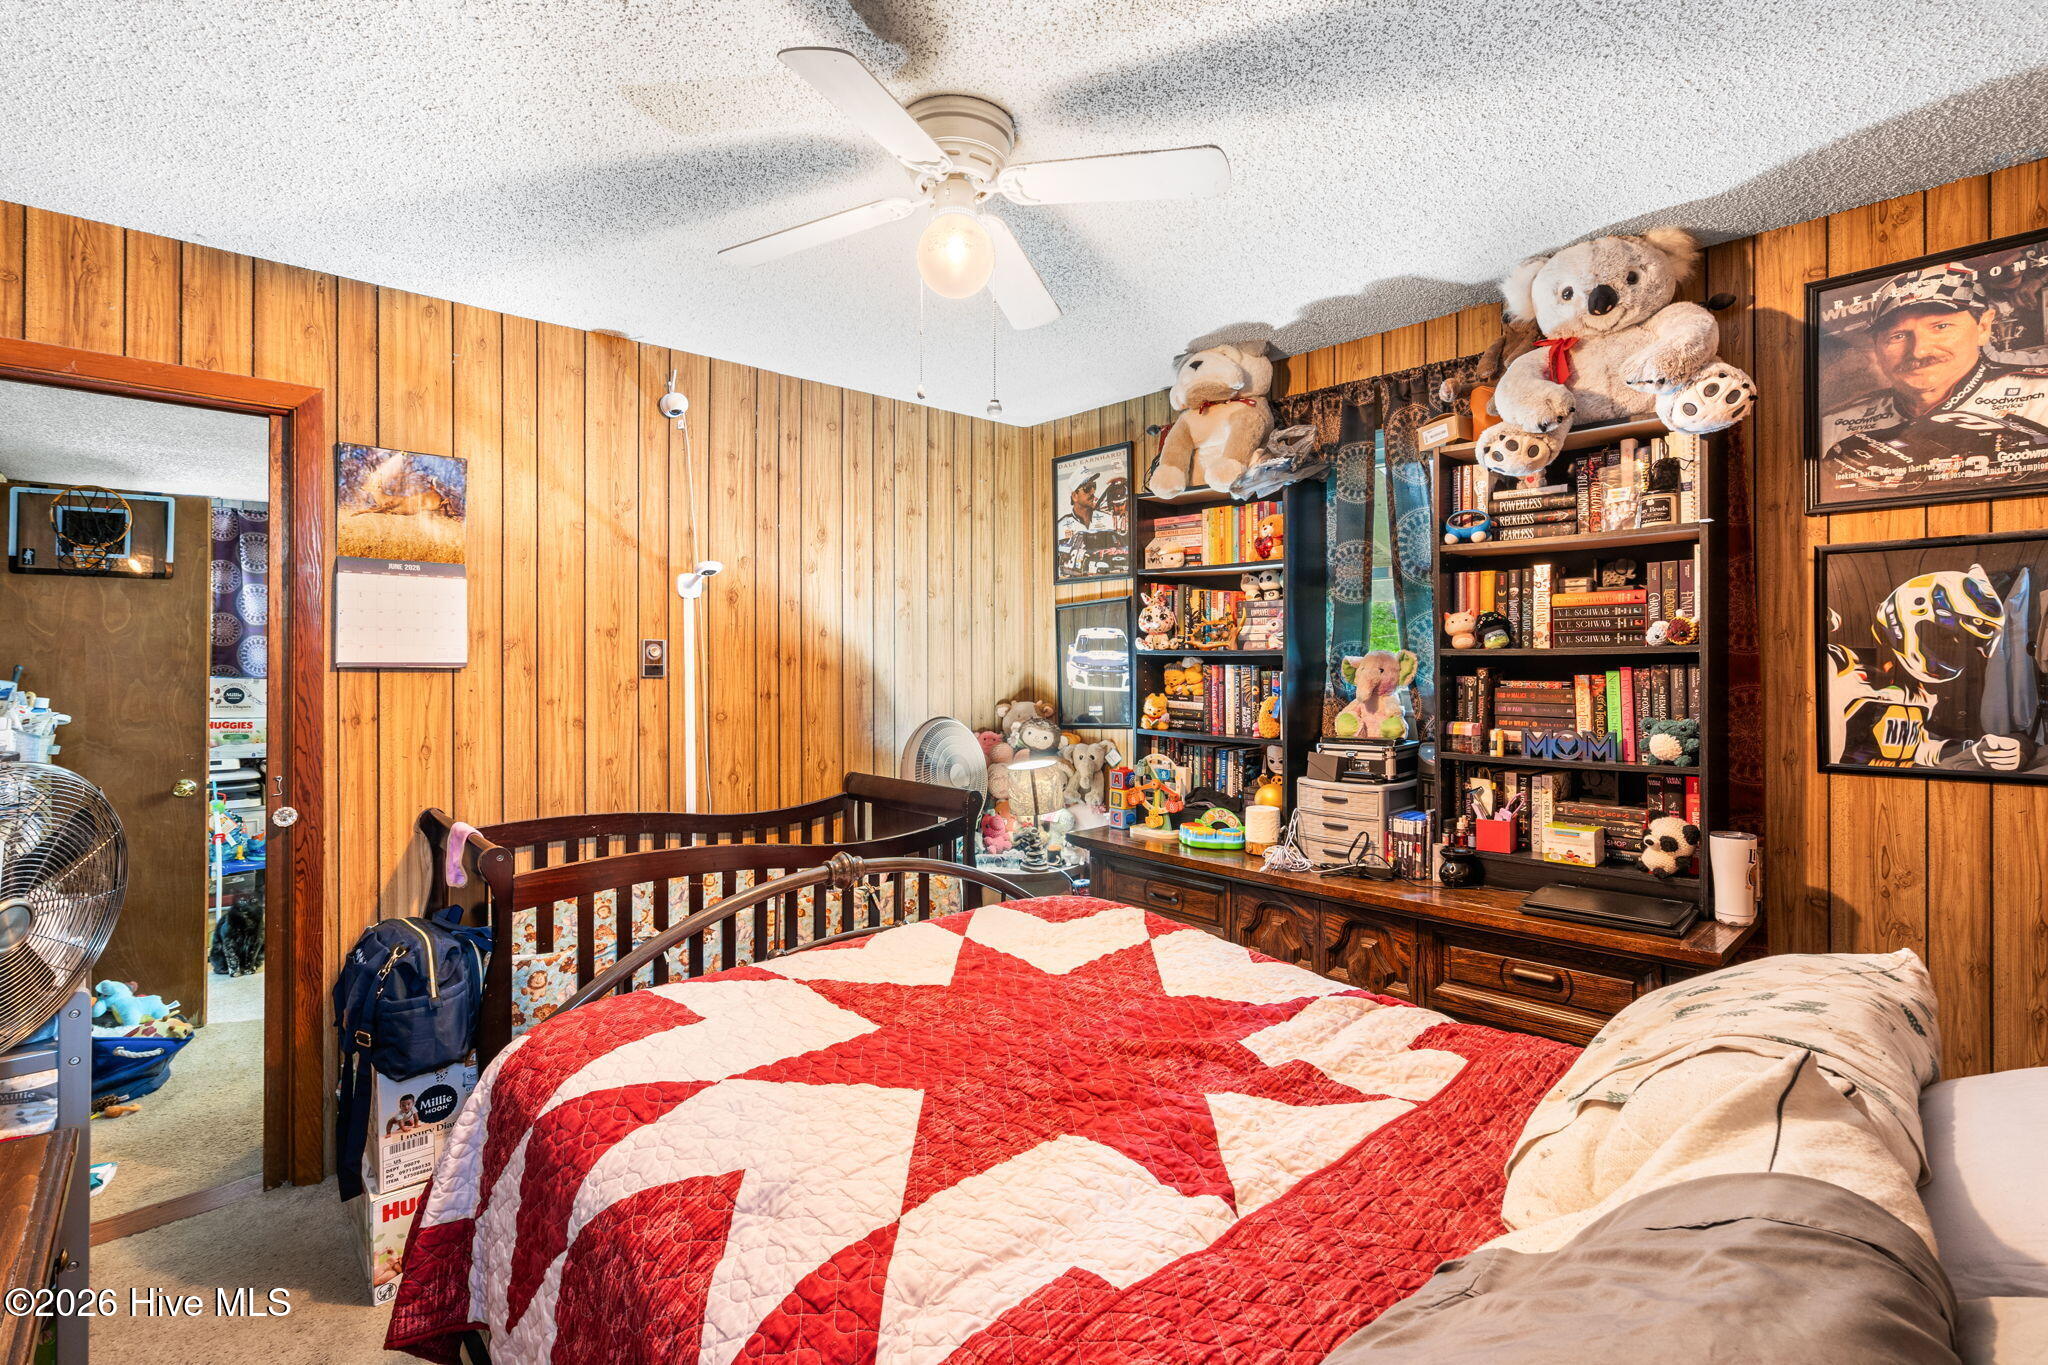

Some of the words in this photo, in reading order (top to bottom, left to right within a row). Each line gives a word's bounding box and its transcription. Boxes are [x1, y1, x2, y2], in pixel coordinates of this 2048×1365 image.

[1975, 392, 2045, 405] Goodwrench
[1992, 402, 2024, 410] Service
[1834, 413, 1895, 426] Goodwrench
[1846, 423, 1877, 432] Service
[1058, 462, 1077, 470] DALE
[1080, 450, 1126, 465] EARNHARDT
[1500, 497, 1542, 512] POWERLESS
[1500, 513, 1534, 526] RECKLESS
[1500, 527, 1535, 540] FEARLESS
[1574, 607, 1610, 616] SCHWAB
[1575, 619, 1611, 628] SCHWAB
[1575, 635, 1611, 643] SCHWAB
[1641, 697, 1650, 718] FOXGL
[1658, 694, 1666, 721] HEMLOC
[209, 721, 253, 729] HUGGIES
[1521, 728, 1618, 762] MOM
[420, 1094, 453, 1110] Millie
[424, 1103, 448, 1115] MOON
[385, 1166, 400, 1174] DEPT
